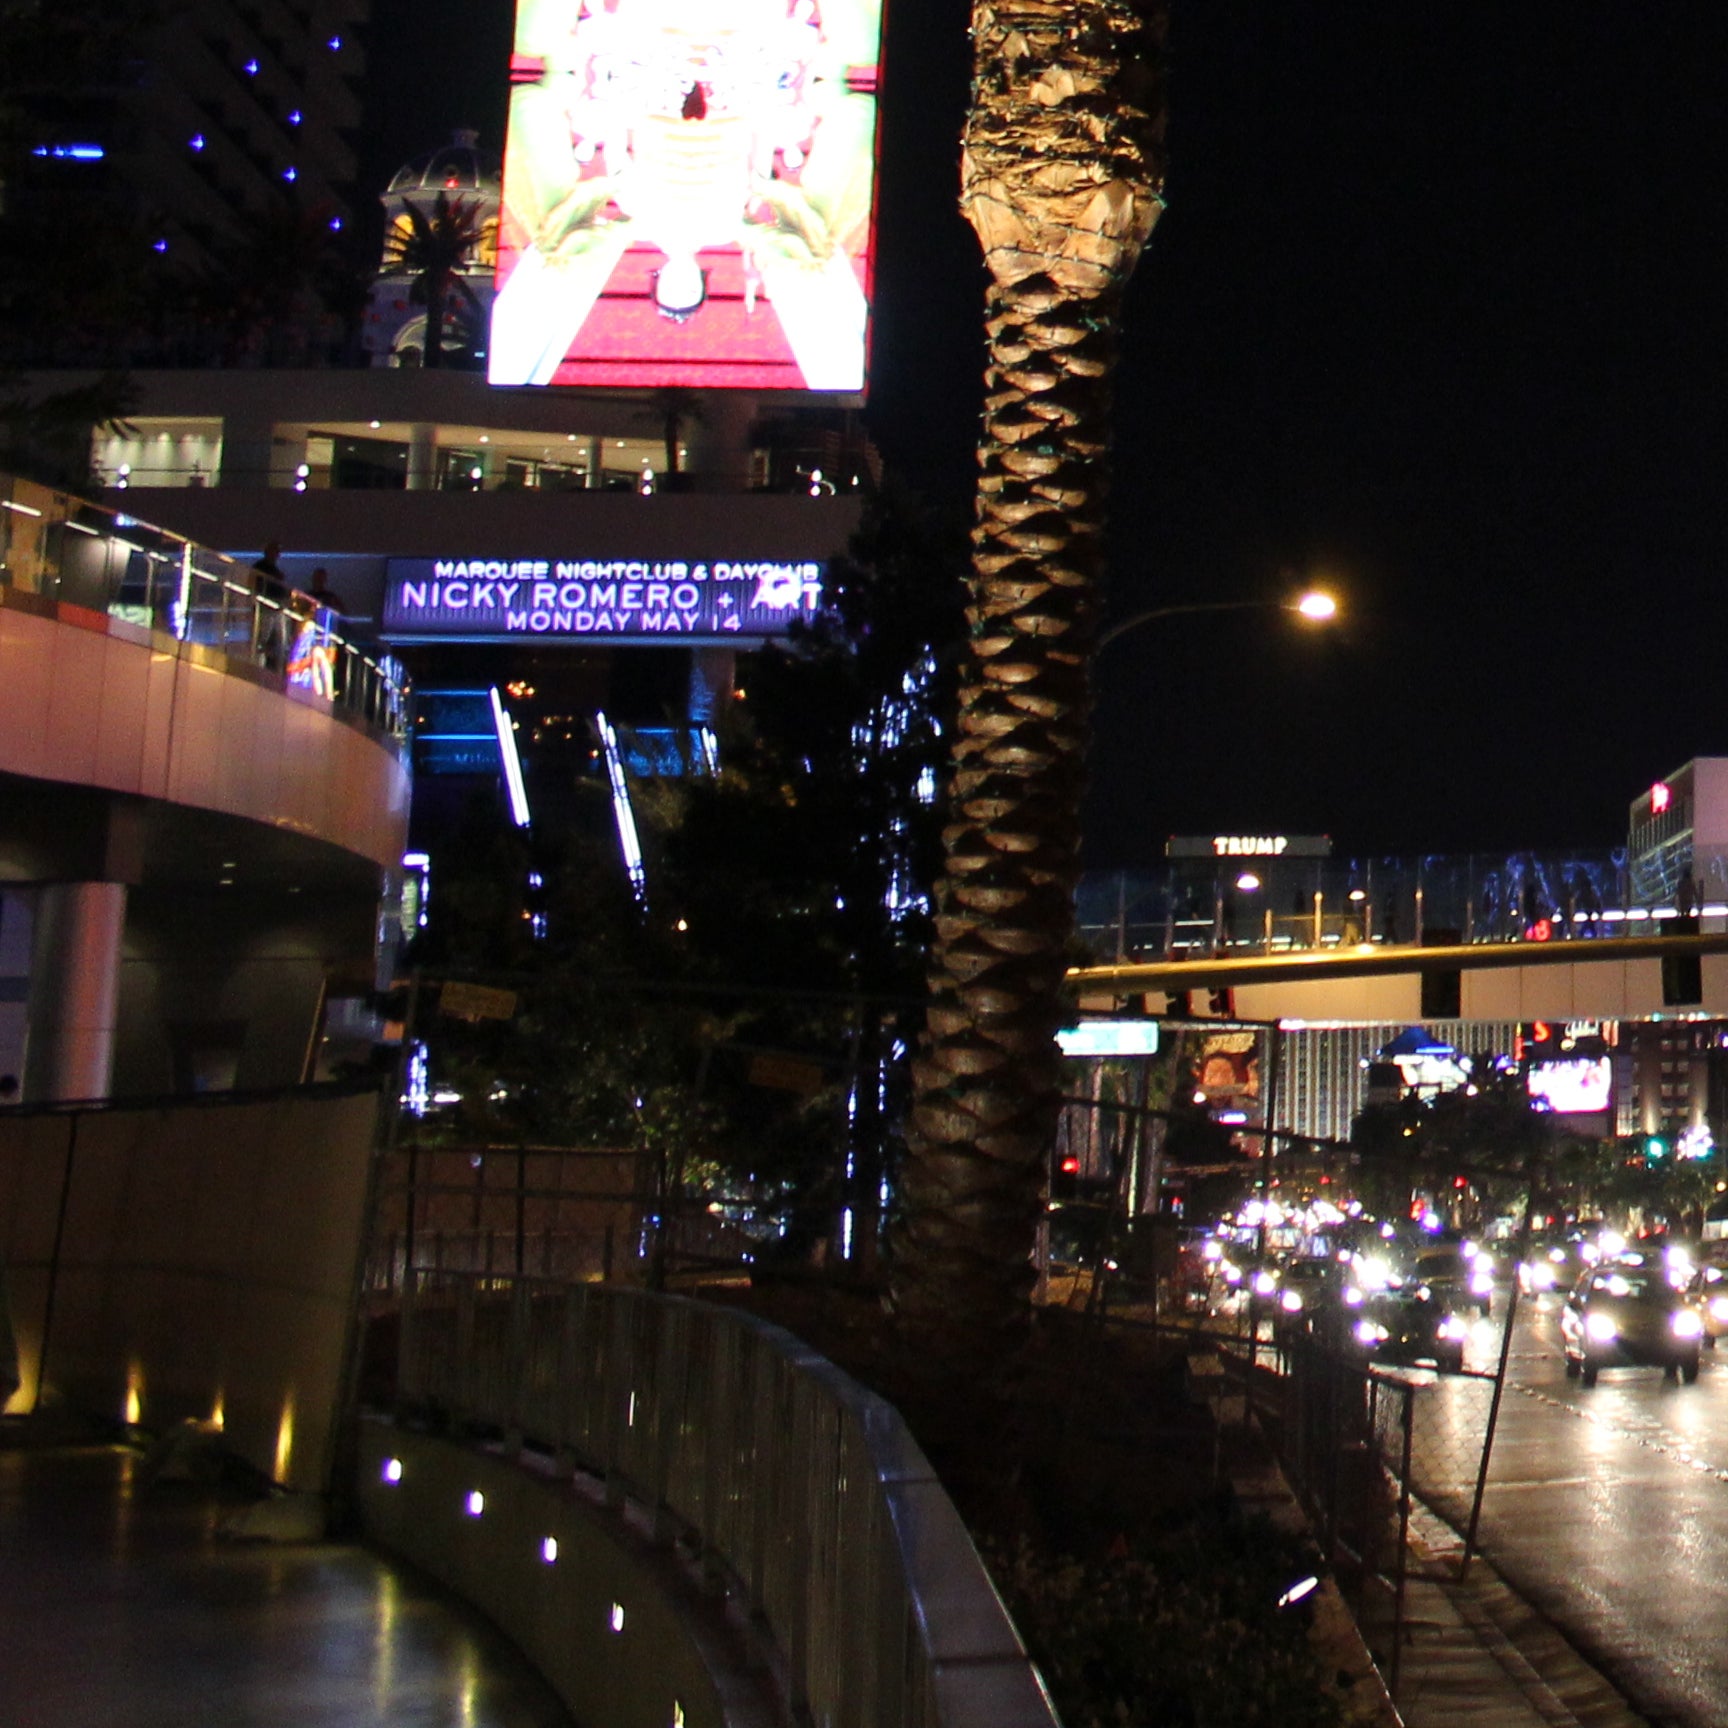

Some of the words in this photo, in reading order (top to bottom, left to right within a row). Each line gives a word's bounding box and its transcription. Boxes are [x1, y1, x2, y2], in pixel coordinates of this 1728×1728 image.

[434, 561, 549, 581] MARQUEE
[556, 561, 688, 581] NIGHTCLUB
[402, 582, 520, 609] NICKY
[532, 583, 701, 609] ROMERO
[506, 611, 628, 632] MONDAY
[640, 611, 700, 631] MAY
[711, 613, 742, 631] 14
[1213, 835, 1289, 856] TRUMP
